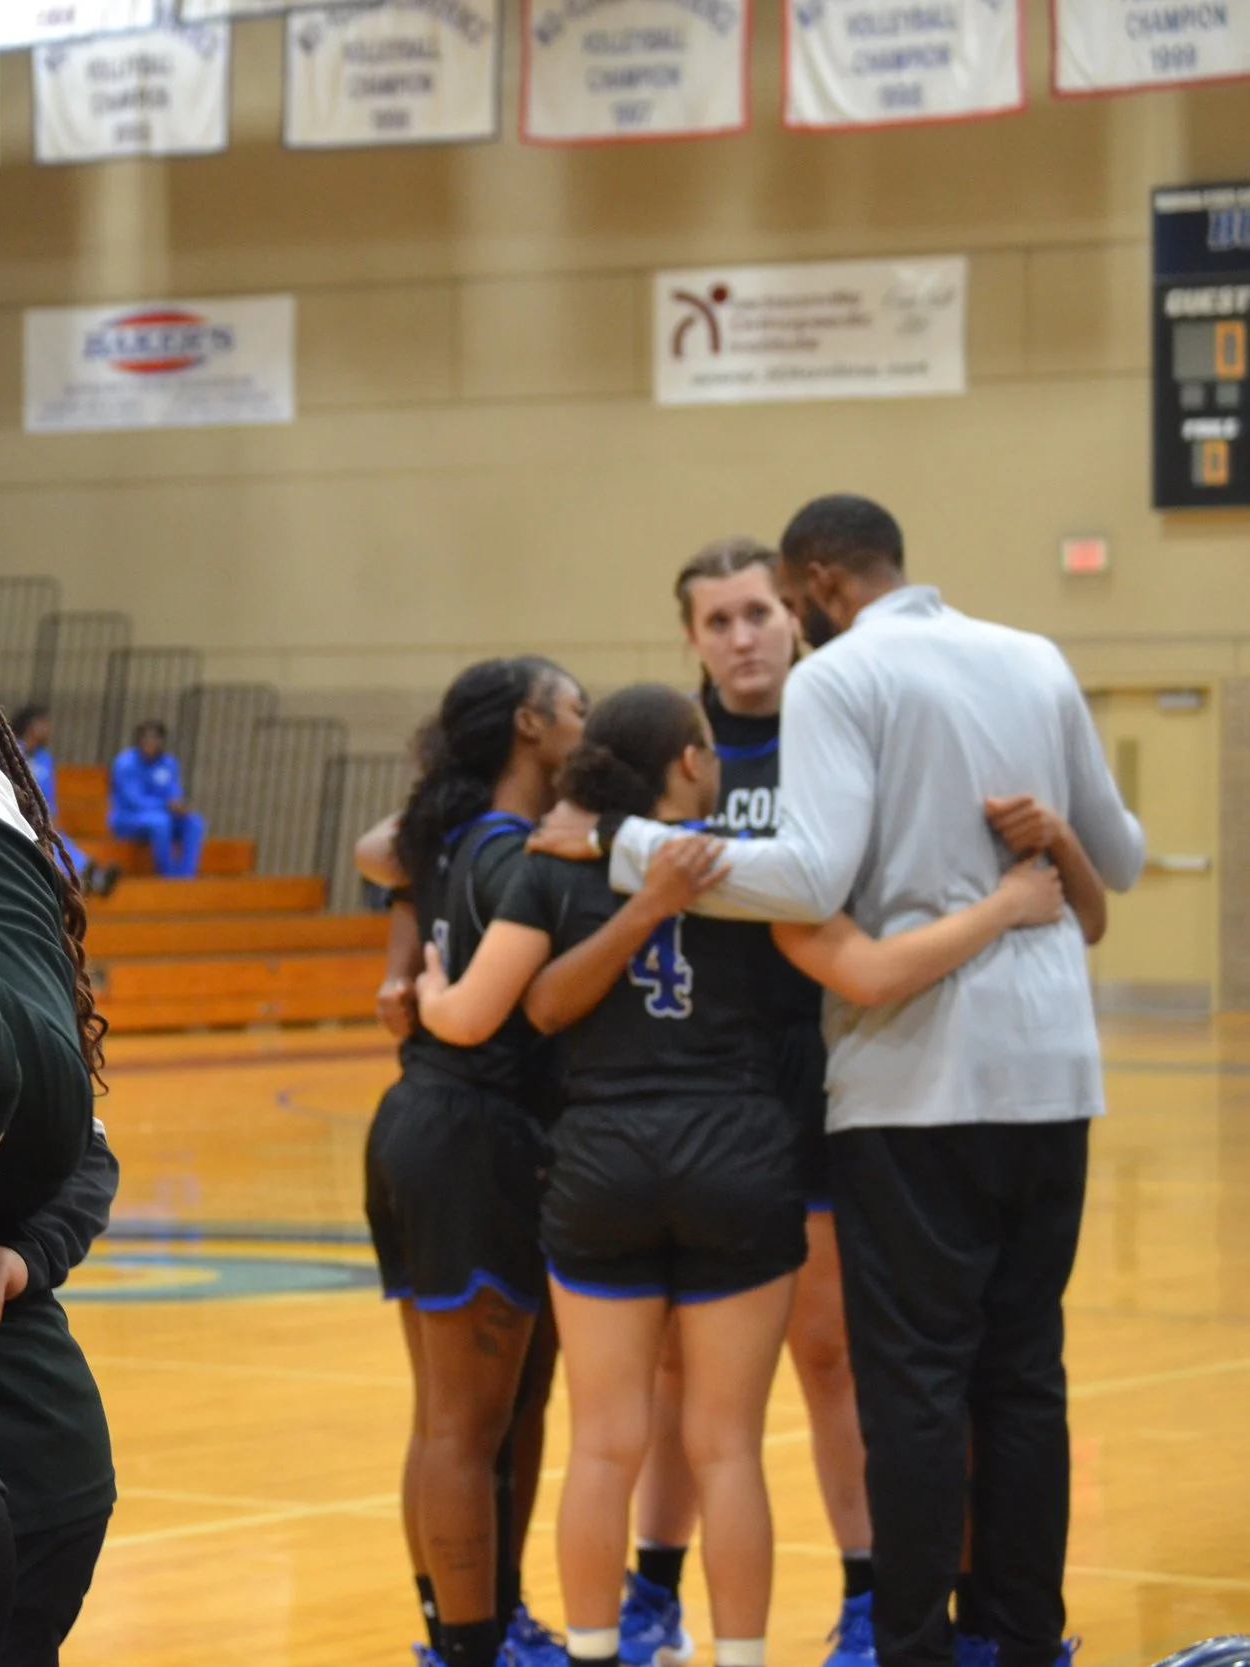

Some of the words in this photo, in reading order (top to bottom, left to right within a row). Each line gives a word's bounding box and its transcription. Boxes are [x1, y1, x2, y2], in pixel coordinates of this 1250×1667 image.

[1125, 6, 1229, 40] CHAMPION
[853, 46, 951, 75] CHAMPION
[349, 73, 434, 98] CHAMPION
[587, 65, 680, 92] CHAMPION
[1165, 285, 1250, 318] GUEST
[1215, 320, 1246, 380] 0
[1202, 439, 1230, 487] 0
[631, 912, 693, 1018] 4
